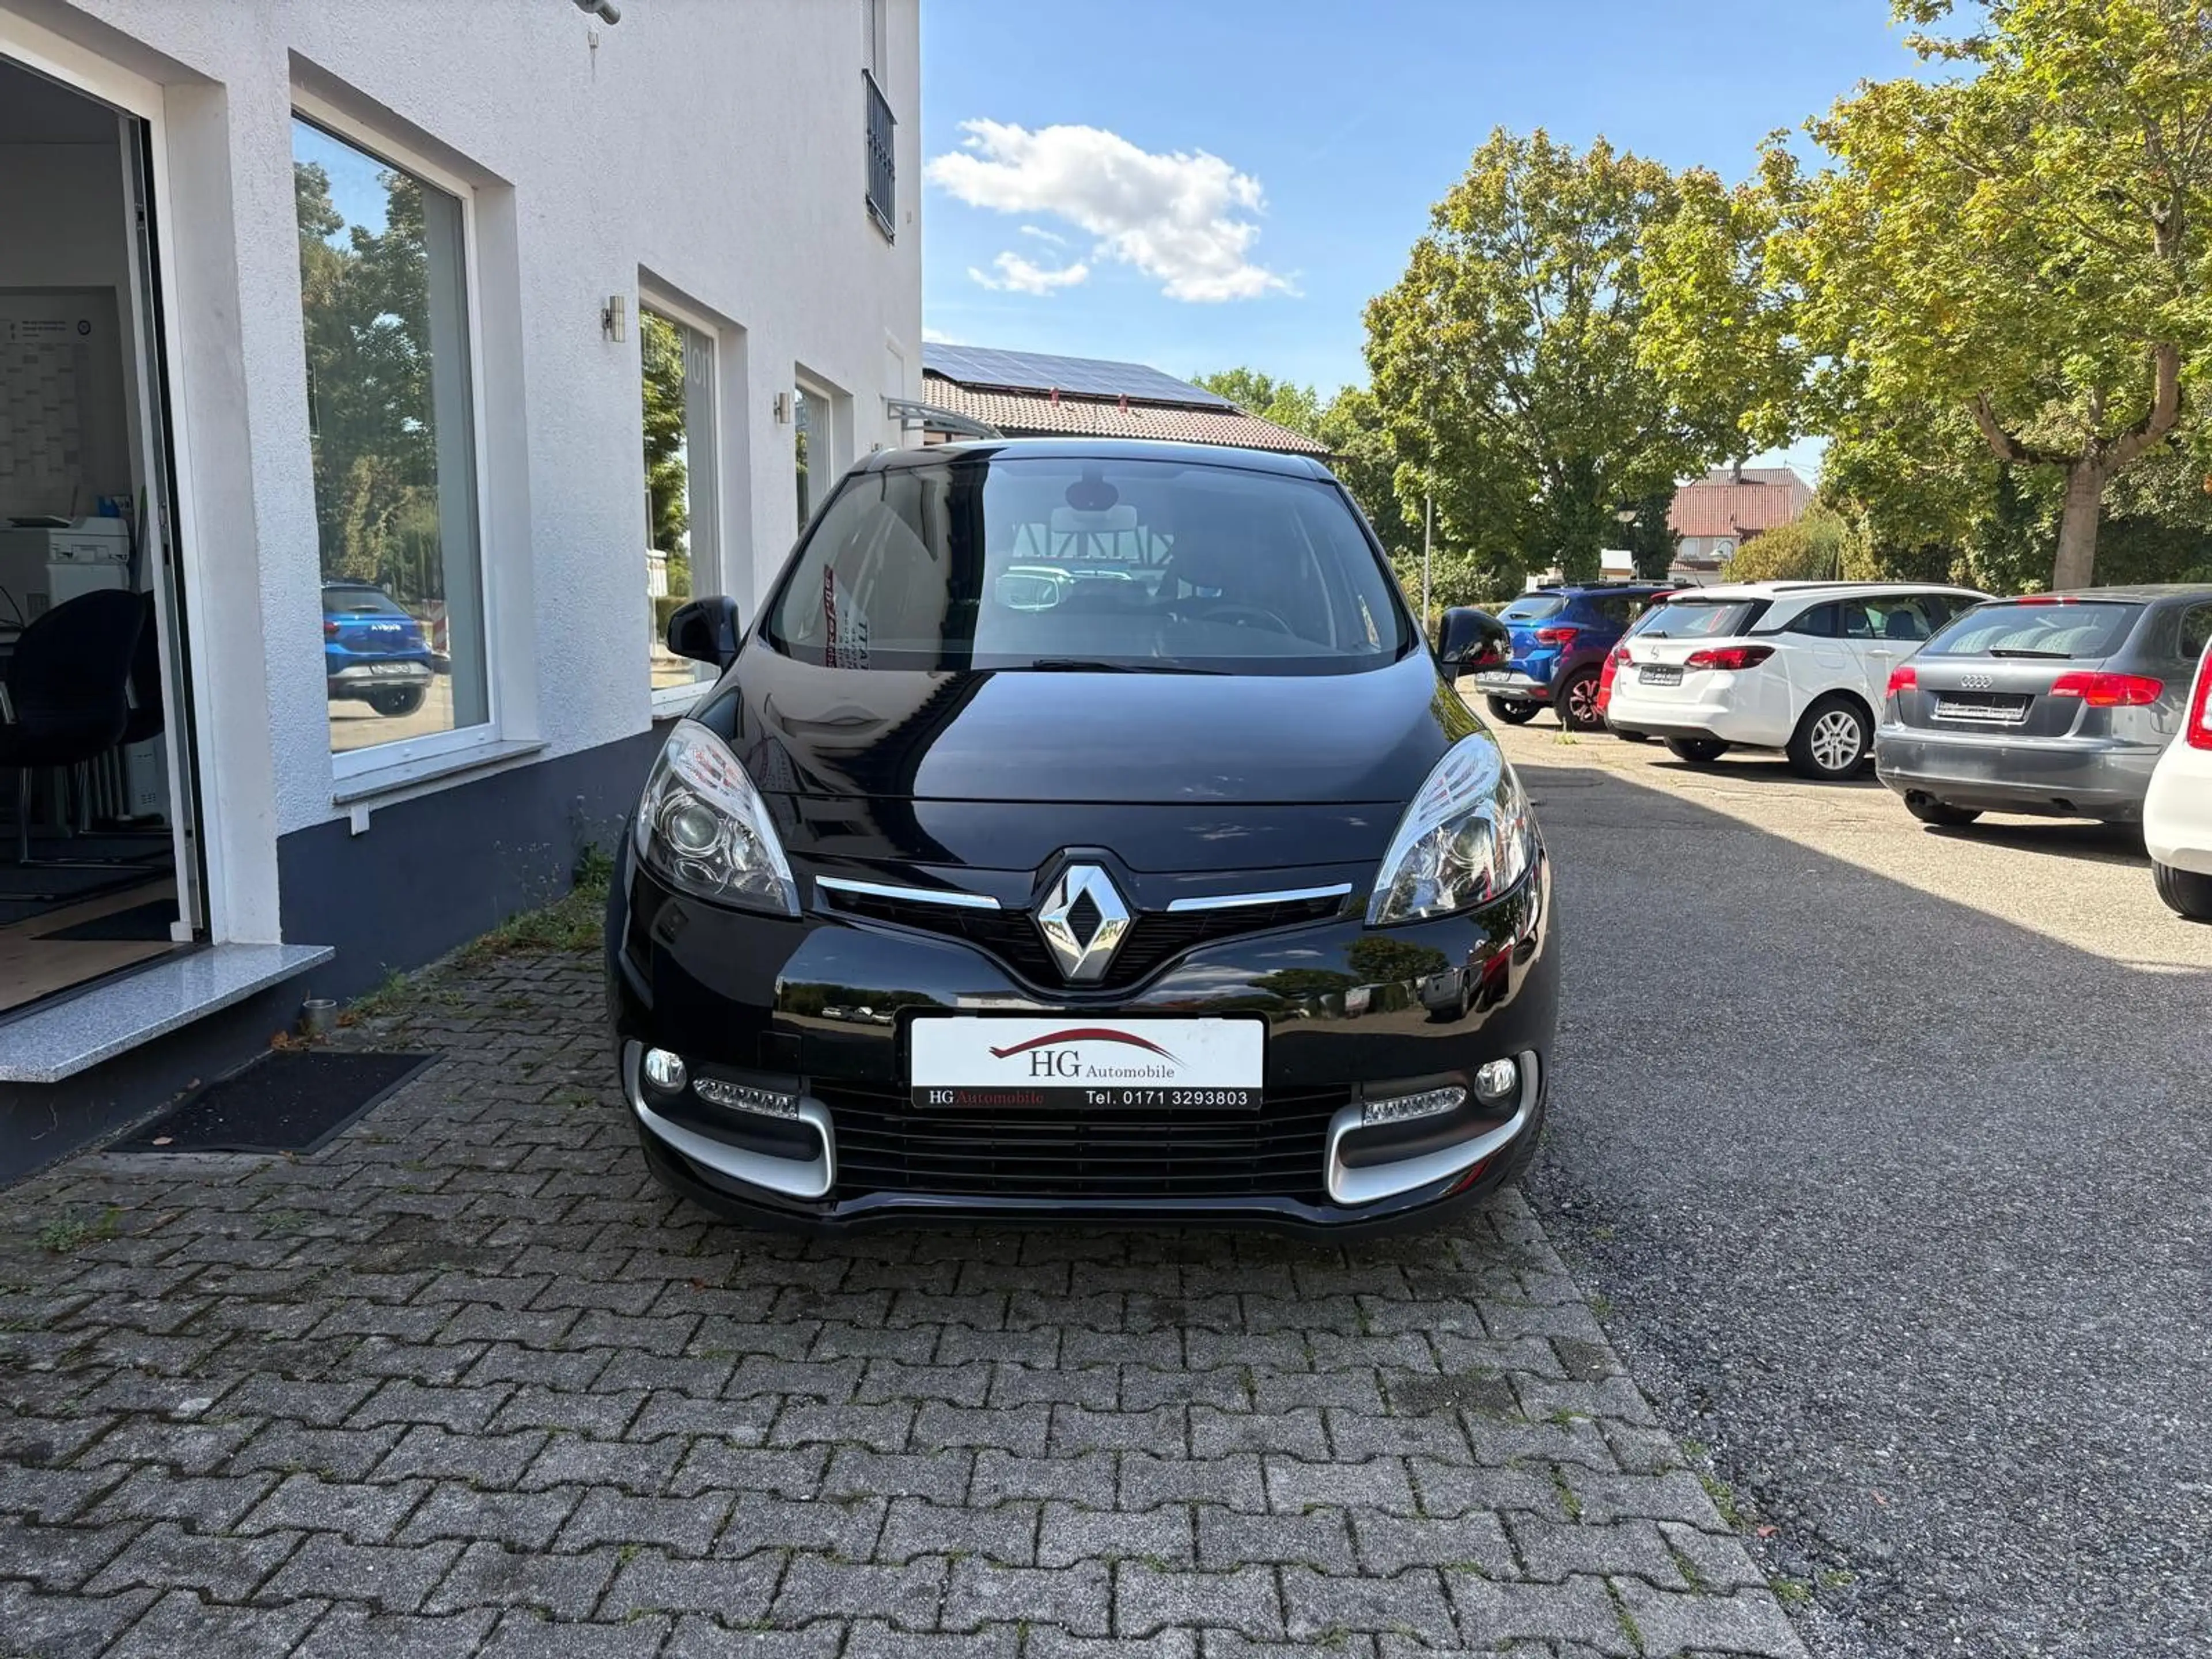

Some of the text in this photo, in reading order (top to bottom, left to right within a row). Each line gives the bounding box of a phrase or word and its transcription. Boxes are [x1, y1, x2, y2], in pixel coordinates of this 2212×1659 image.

[1029, 1050, 1175, 1078] HG Automobile
[929, 1090, 1044, 1104] HG Automobile
[1086, 1090, 1248, 1105] Tel. 0171 3293803
